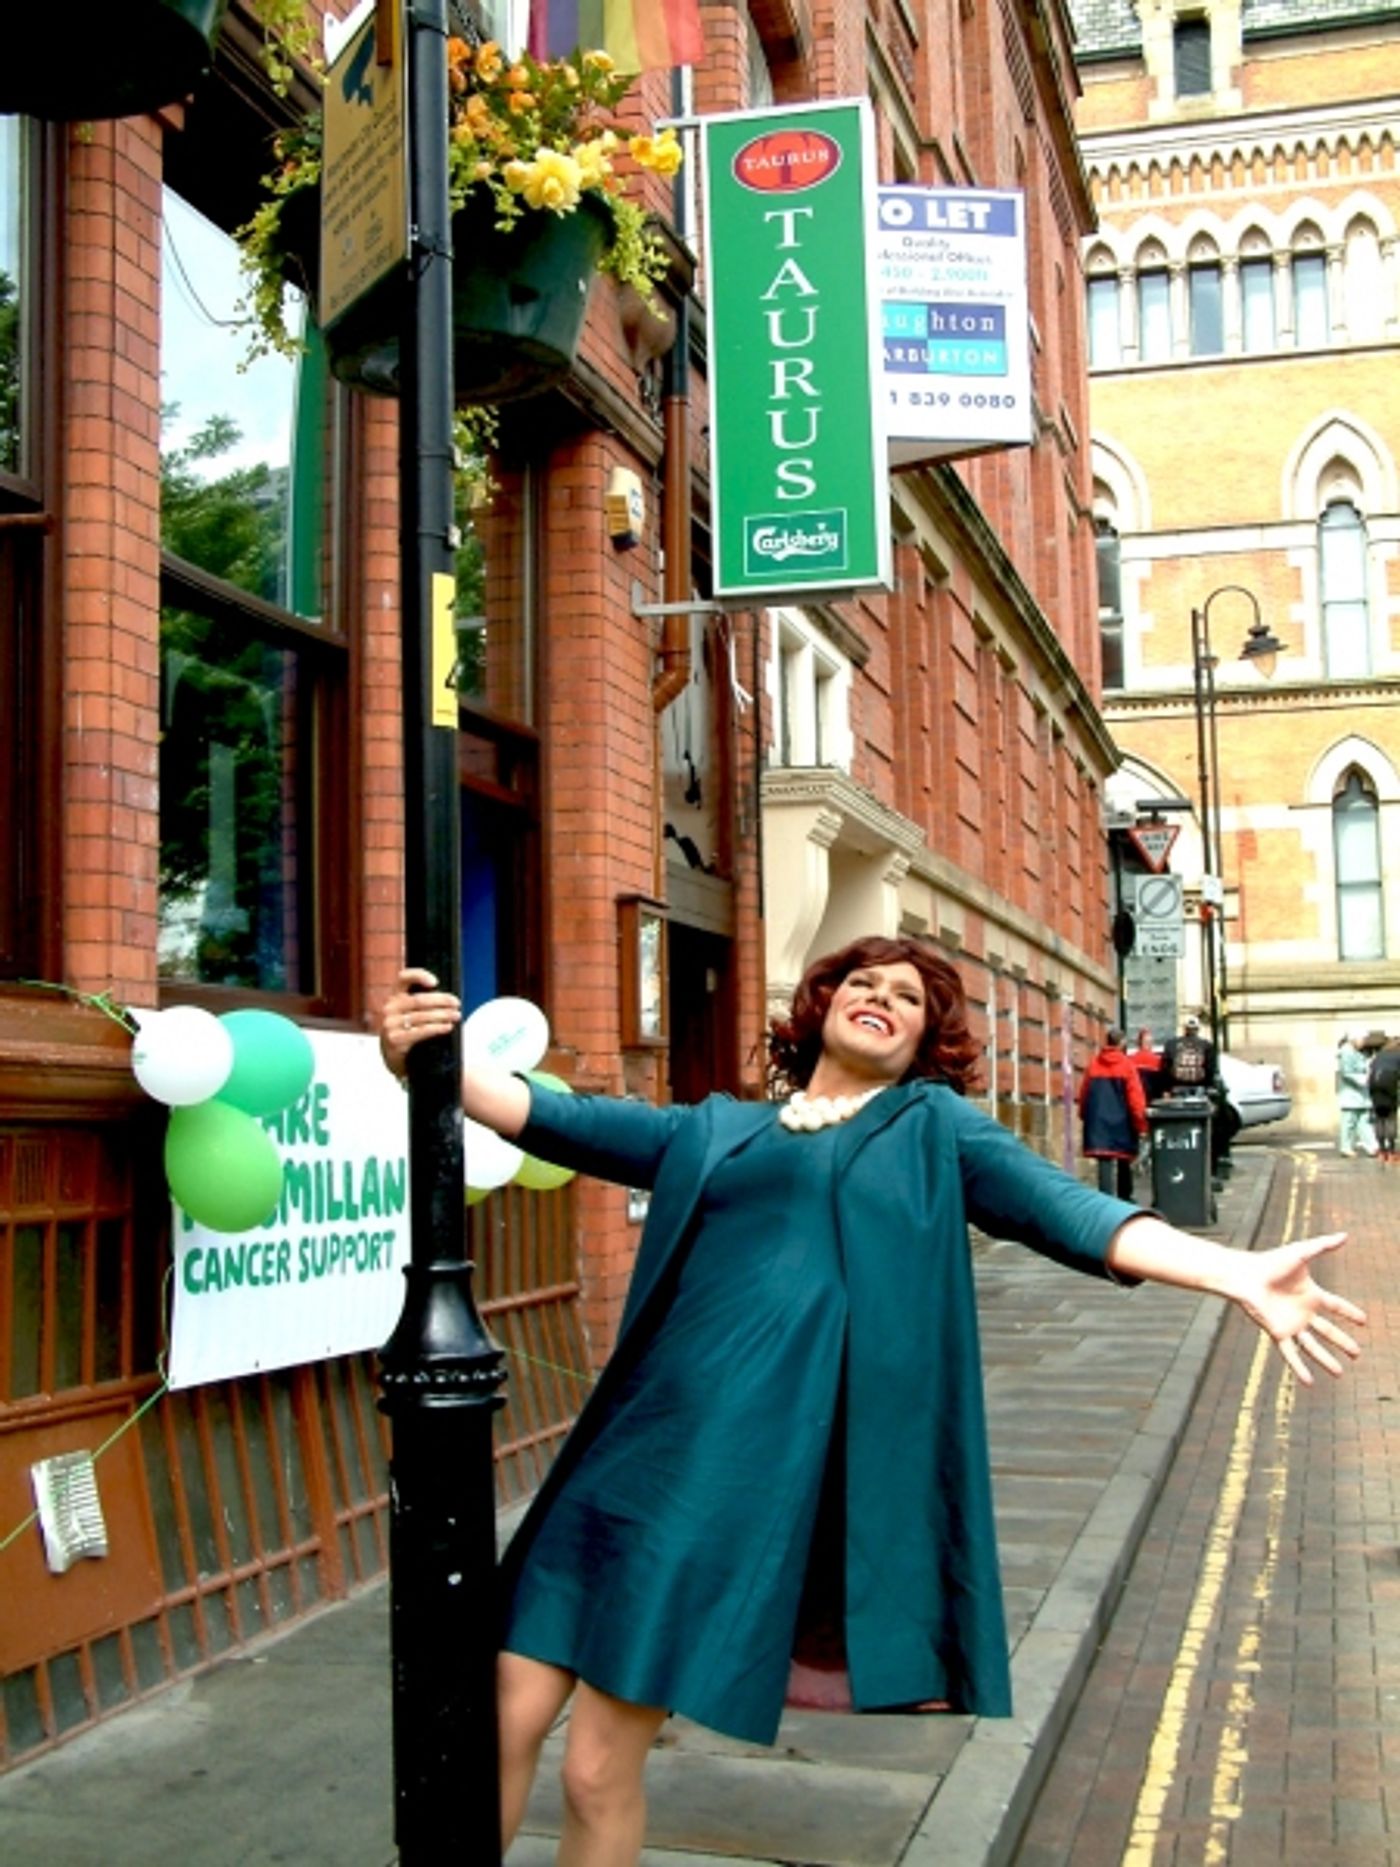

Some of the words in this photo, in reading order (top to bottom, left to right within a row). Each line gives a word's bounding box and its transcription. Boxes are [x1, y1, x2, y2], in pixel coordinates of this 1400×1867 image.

[743, 148, 829, 171] TAURUS
[878, 198, 914, 226] O
[926, 199, 991, 230] LET
[759, 206, 822, 500] TAURUS
[908, 392, 950, 406] 839
[958, 393, 1016, 409] 0080
[752, 522, 839, 562] Carlsberg
[183, 1238, 291, 1295] CANCER
[298, 1229, 396, 1283] SUPPORT
